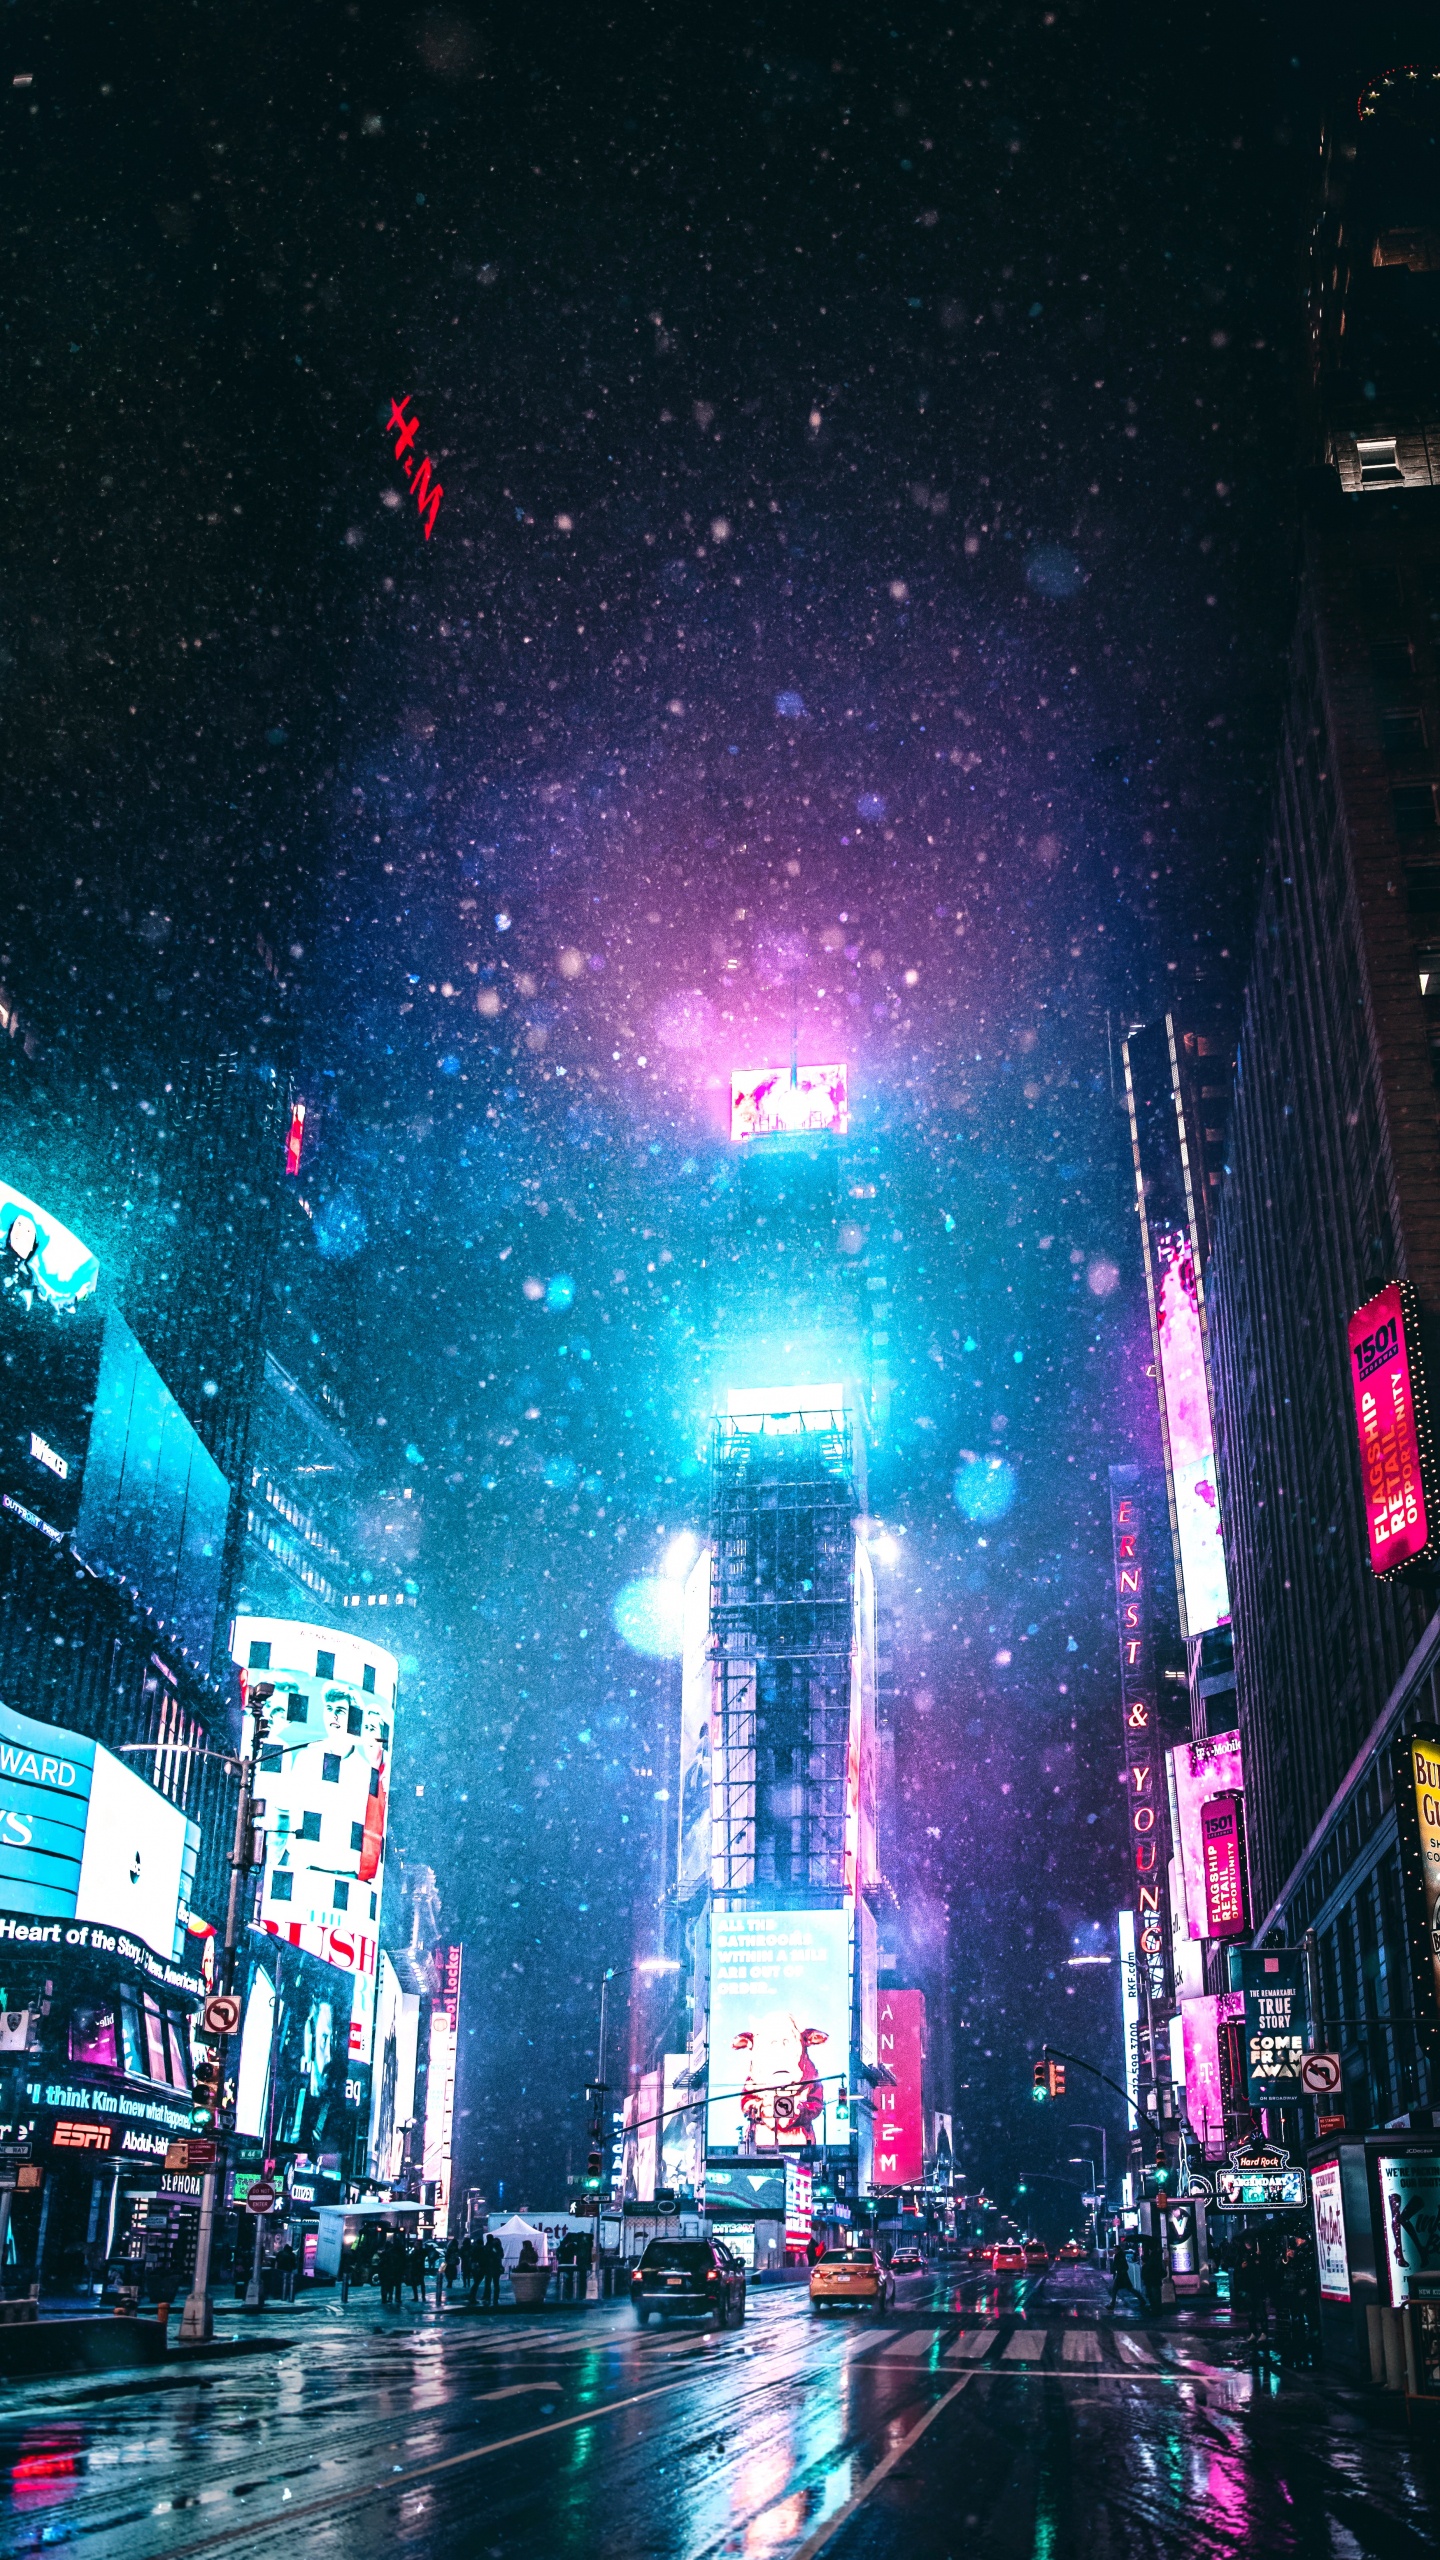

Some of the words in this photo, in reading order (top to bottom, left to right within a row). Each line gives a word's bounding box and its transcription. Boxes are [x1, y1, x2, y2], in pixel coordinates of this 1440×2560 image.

[1354, 1317, 1397, 1369] 1501
[1359, 1345, 1399, 1381] BROADWAY
[1391, 1372, 1418, 1525] OPPORTUNITY
[1362, 1391, 1390, 1544] FLAGSHIP
[1381, 1425, 1406, 1536] RETAIL
[1118, 1500, 1142, 1666] ERNST
[1127, 1703, 1149, 1729] &
[1204, 1814, 1233, 1834] 1501
[1132, 1766, 1162, 1954] YOUNG
[1207, 1845, 1222, 1923] FLAGSHIP
[1218, 1867, 1231, 1921] RETAIL
[1227, 1842, 1239, 1919] OPPORTUNITY
[0, 1919, 62, 1942] Heart
[66, 1927, 90, 1945] of
[91, 1930, 116, 1952] the
[717, 1919, 744, 1932] ALL
[747, 1918, 776, 1931] THE
[717, 1932, 812, 1947] BATHROOMS
[444, 1946, 459, 1994] Locker
[717, 1950, 773, 1963] WITHIN
[776, 1950, 788, 1962] A
[790, 1949, 828, 1962] MILE
[717, 1966, 747, 1979] ARE
[750, 1965, 781, 1979] OUT
[783, 1965, 804, 1978] OF
[1127, 1951, 1137, 1999] RKF.com
[1250, 1989, 1260, 1998] THE
[1261, 1988, 1297, 1997] REMARKABLE
[1258, 1997, 1292, 2015] TRUE
[444, 1998, 457, 2029] oot
[1259, 2015, 1291, 2029] STORY
[1249, 2035, 1303, 2050] COME
[880, 2004, 898, 2172] ANHEM
[46, 2086, 91, 2110] think
[92, 2090, 117, 2113] Kim
[119, 2095, 145, 2116] knew
[146, 2102, 164, 2122] what
[53, 2121, 112, 2150] ESPN
[1240, 2157, 1260, 2166] Hard
[1260, 2157, 1279, 2167] Rock
[1385, 2167, 1410, 2178] WE'RE
[161, 2174, 201, 2196] SEPHORA
[1400, 2178, 1417, 2188] OUR
